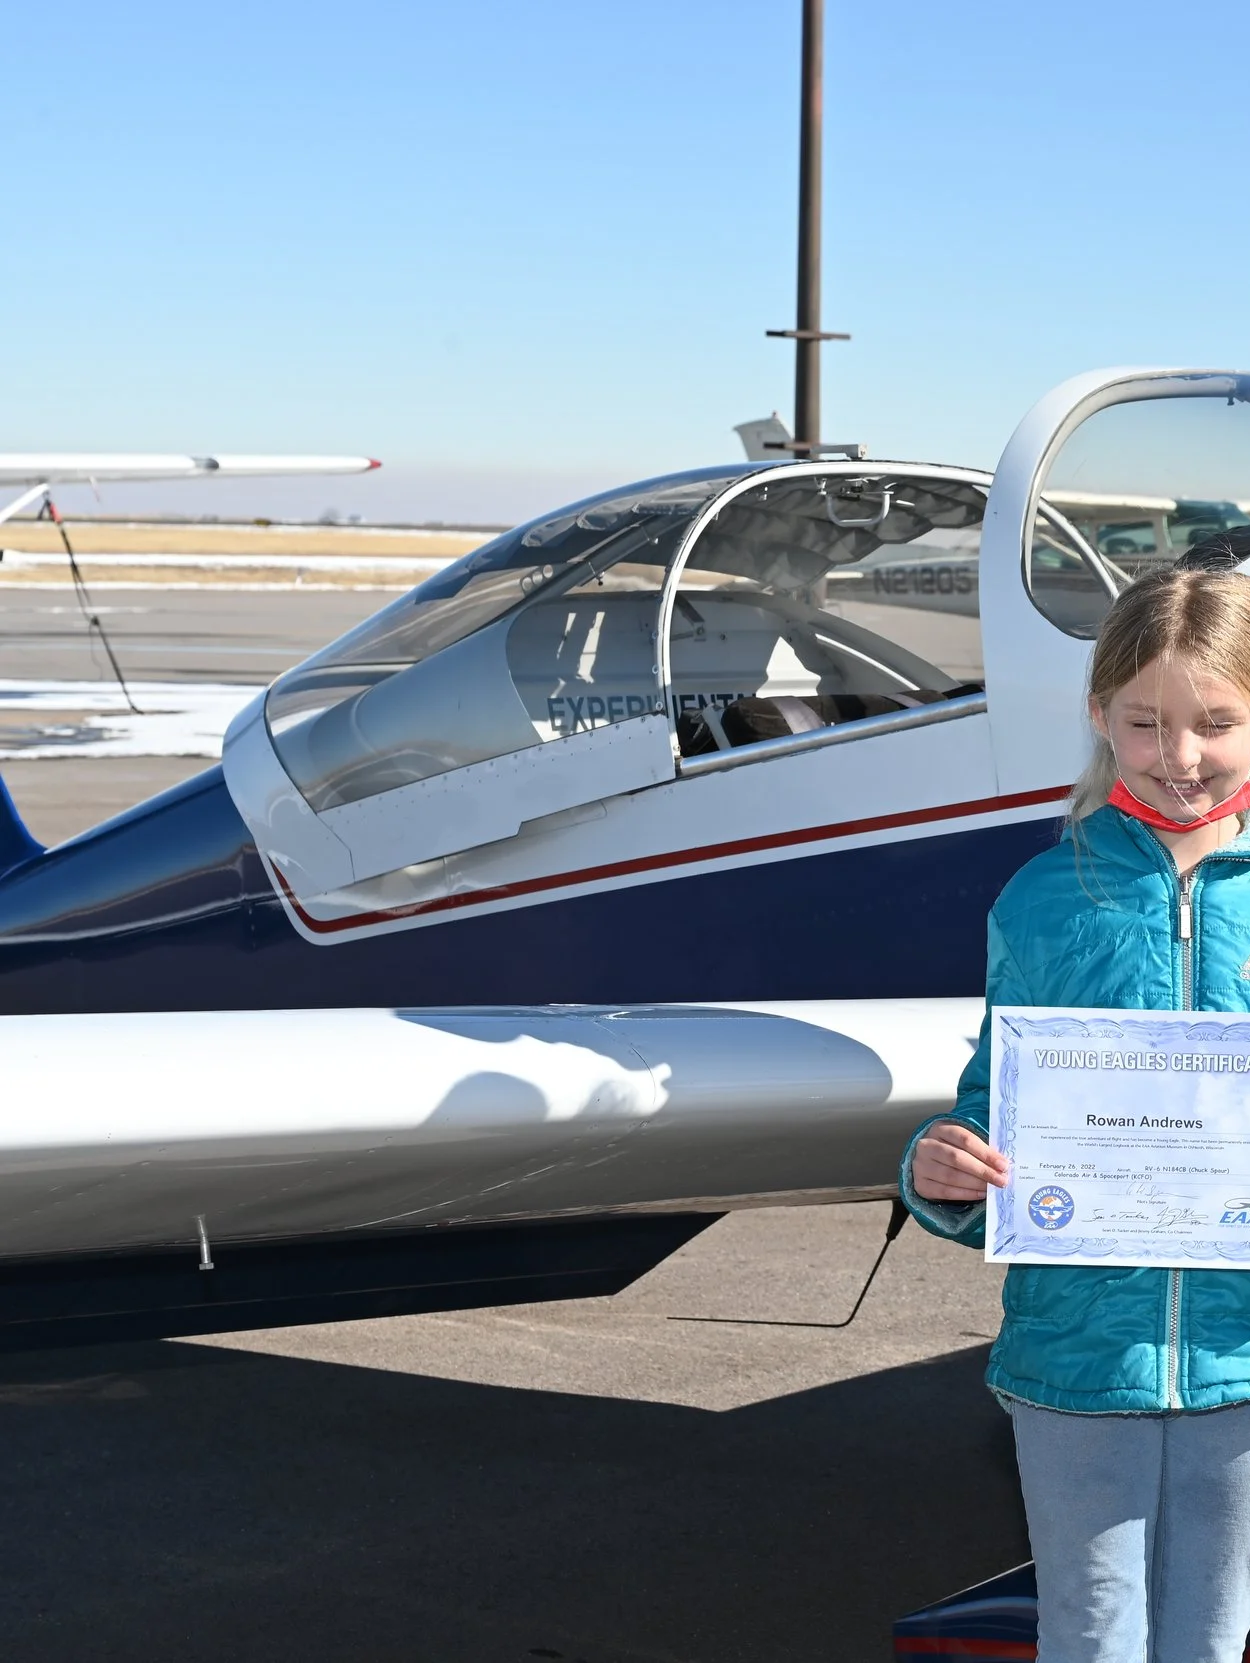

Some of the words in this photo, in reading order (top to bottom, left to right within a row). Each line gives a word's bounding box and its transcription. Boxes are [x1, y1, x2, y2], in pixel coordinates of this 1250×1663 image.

[547, 693, 758, 732] EXPERIENT
[1034, 1049, 1097, 1069] YOUNG
[1101, 1051, 1167, 1071] EAGLES
[1086, 1114, 1135, 1127] Rowan
[1140, 1116, 1203, 1129] Andrews
[1033, 1188, 1051, 1203] YOUNG
[1053, 1188, 1070, 1204] EAGLES
